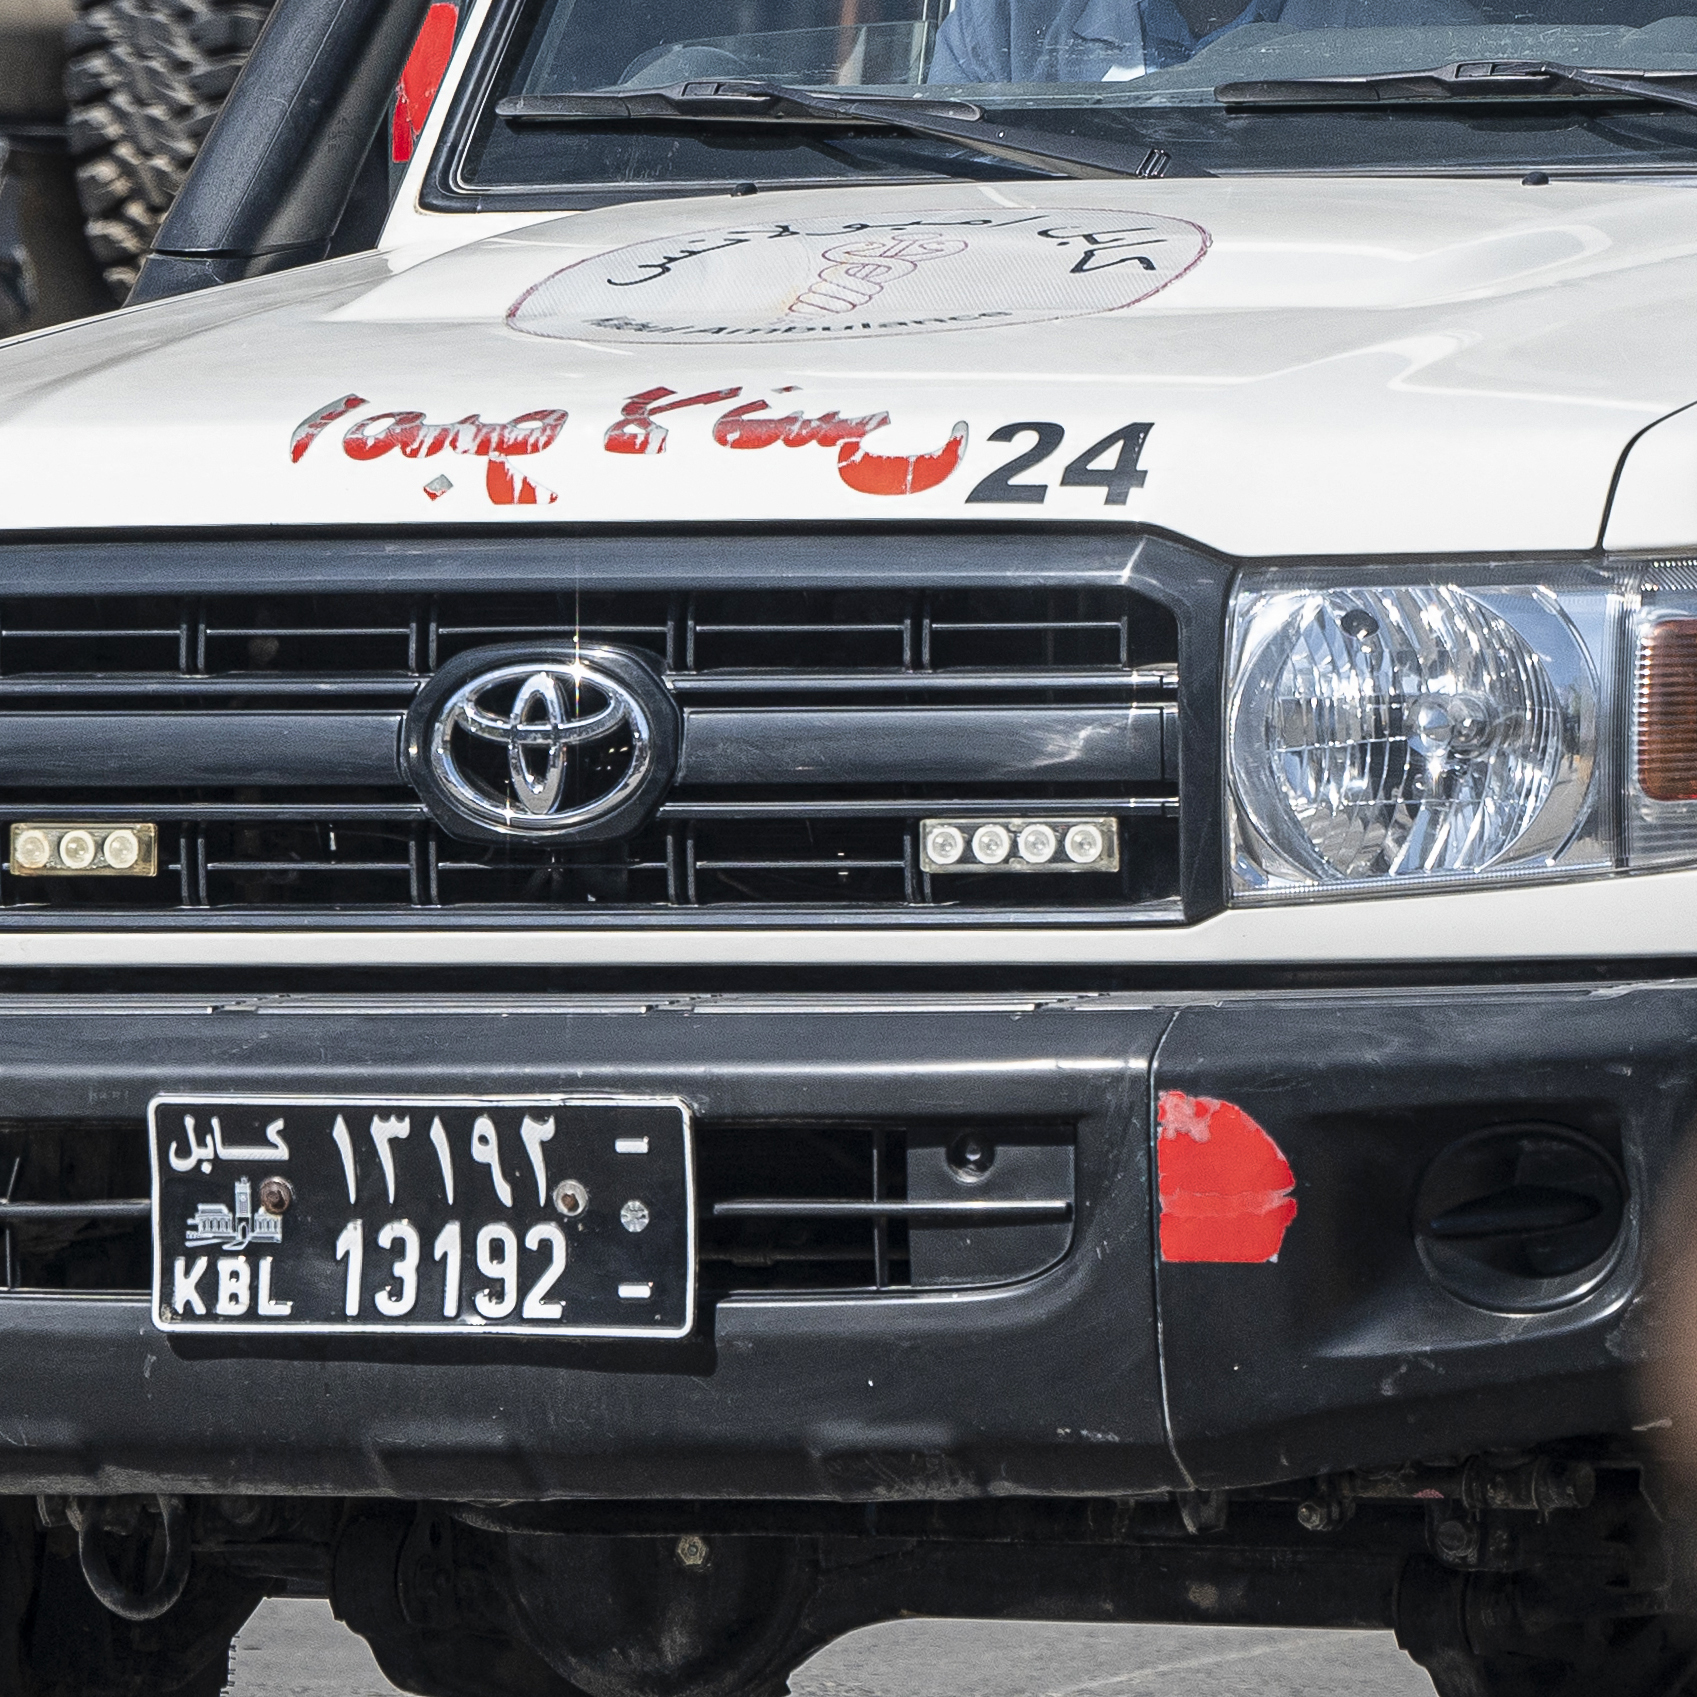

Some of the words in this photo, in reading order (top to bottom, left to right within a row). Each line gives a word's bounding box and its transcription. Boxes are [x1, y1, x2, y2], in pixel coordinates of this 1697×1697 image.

[964, 420, 1156, 506] 24
[168, 1114, 290, 1174] کابل
[172, 1255, 293, 1317] KBL
[335, 1219, 568, 1320] 13192
